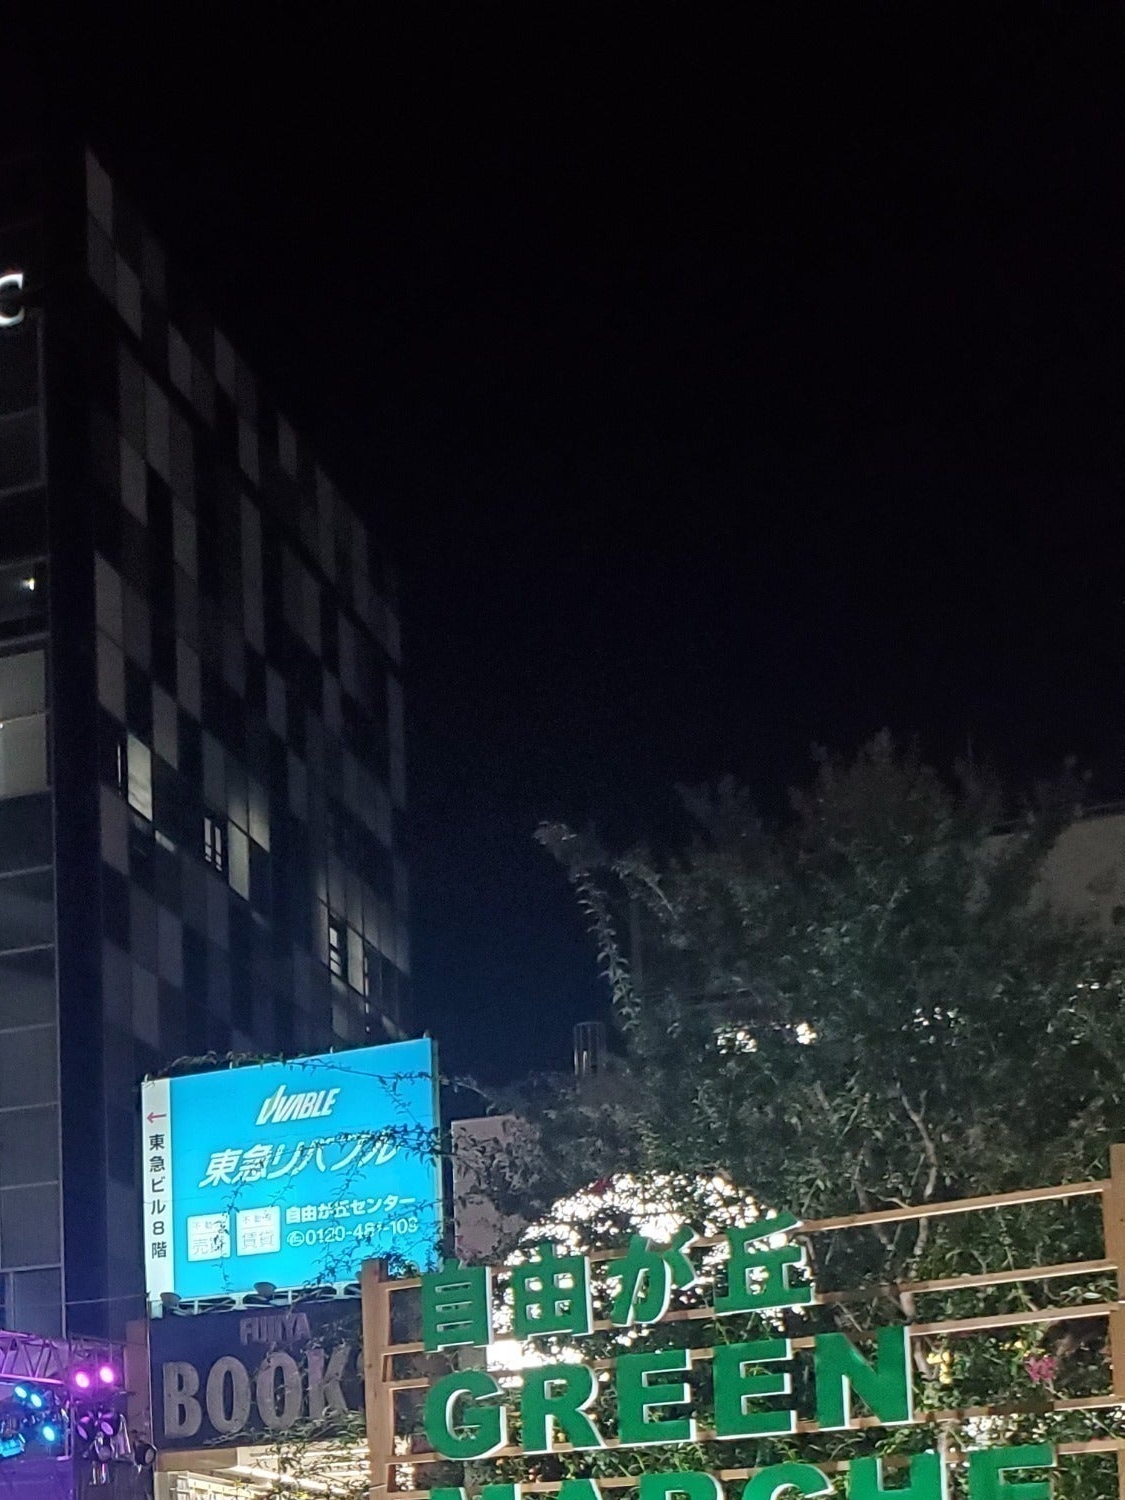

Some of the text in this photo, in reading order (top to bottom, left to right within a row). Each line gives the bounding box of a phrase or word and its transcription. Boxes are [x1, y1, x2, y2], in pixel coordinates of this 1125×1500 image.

[148, 1133, 168, 1259] 東急ビル8階
[285, 1194, 416, 1225] 自由が丘センター
[421, 1213, 818, 1352] 自由が丘
[162, 1349, 364, 1440] BOOK
[423, 1325, 915, 1461] GREEN
